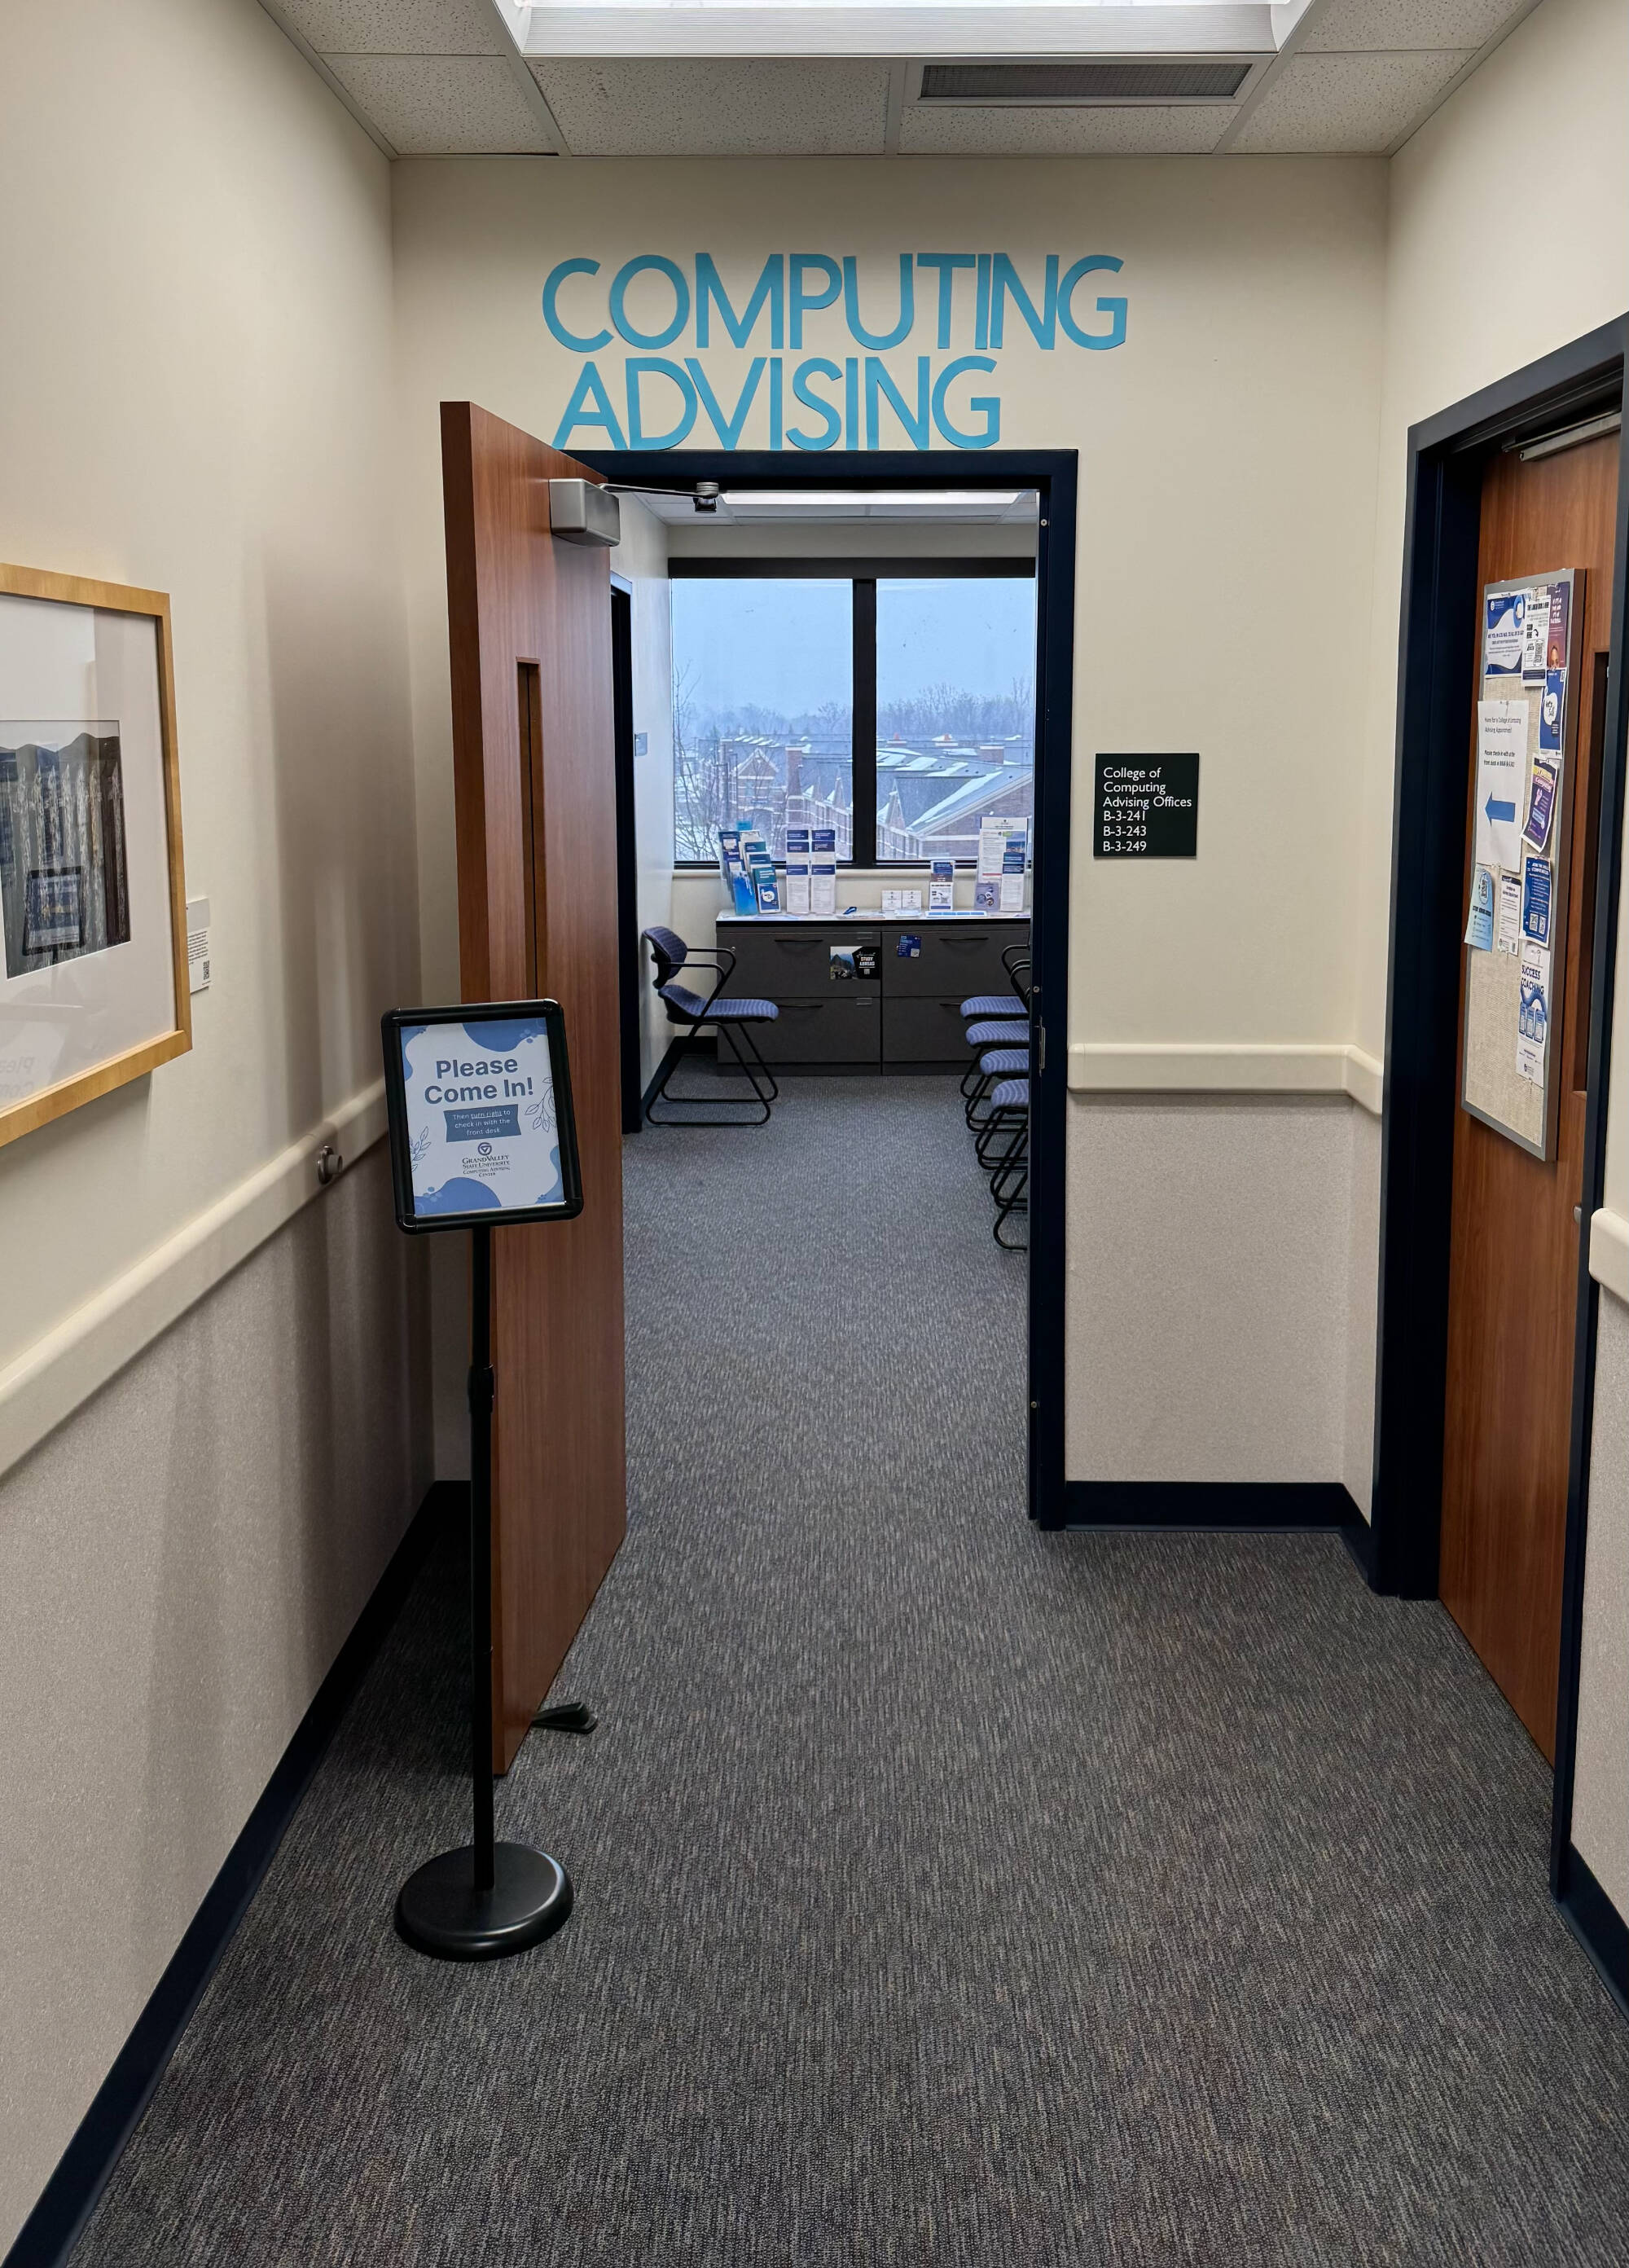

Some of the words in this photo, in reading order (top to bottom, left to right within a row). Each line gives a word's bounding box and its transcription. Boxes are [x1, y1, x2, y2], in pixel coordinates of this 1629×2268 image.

[542, 253, 1128, 353] COMPUTING
[553, 355, 1001, 451] ADVISING
[1103, 767, 1146, 780] College
[1148, 767, 1161, 778] of
[1103, 782, 1166, 795] Computing
[1103, 797, 1150, 810] Advising
[1153, 796, 1192, 807] Offices
[1104, 810, 1146, 821] B-3-241
[1103, 826, 1147, 837] B-3-243
[1103, 841, 1147, 852] B-3-249
[436, 1057, 518, 1079] Please
[425, 1083, 498, 1105] Come
[503, 1077, 533, 1097] In!
